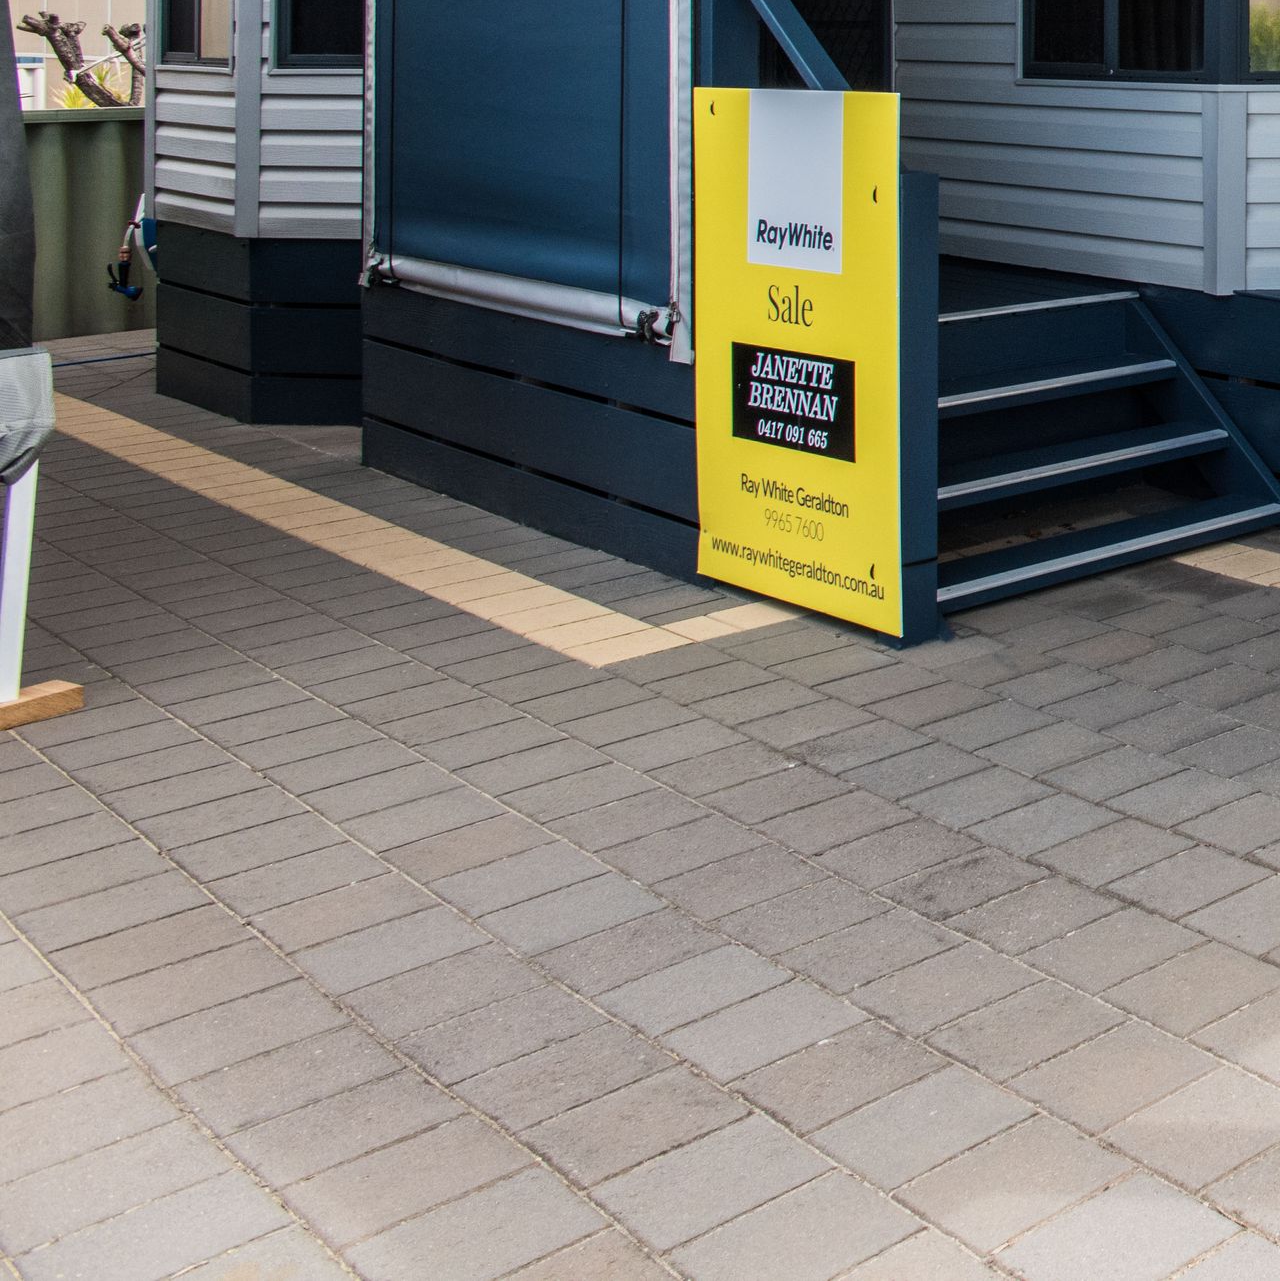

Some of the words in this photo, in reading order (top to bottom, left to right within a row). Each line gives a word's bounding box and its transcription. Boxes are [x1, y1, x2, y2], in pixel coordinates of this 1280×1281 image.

[767, 284, 814, 327] Sale
[751, 352, 834, 390] JANETTE
[747, 381, 838, 423] BRENNAN
[757, 418, 785, 440] 0417
[785, 424, 805, 444] 091
[807, 429, 828, 449] 665
[741, 473, 760, 498] Ray
[761, 478, 794, 504] White
[795, 487, 849, 519] Geraldton
[764, 508, 792, 533] 9965
[794, 516, 825, 542] 7600
[711, 536, 885, 601] www.raywhitegeraldton.com.au
